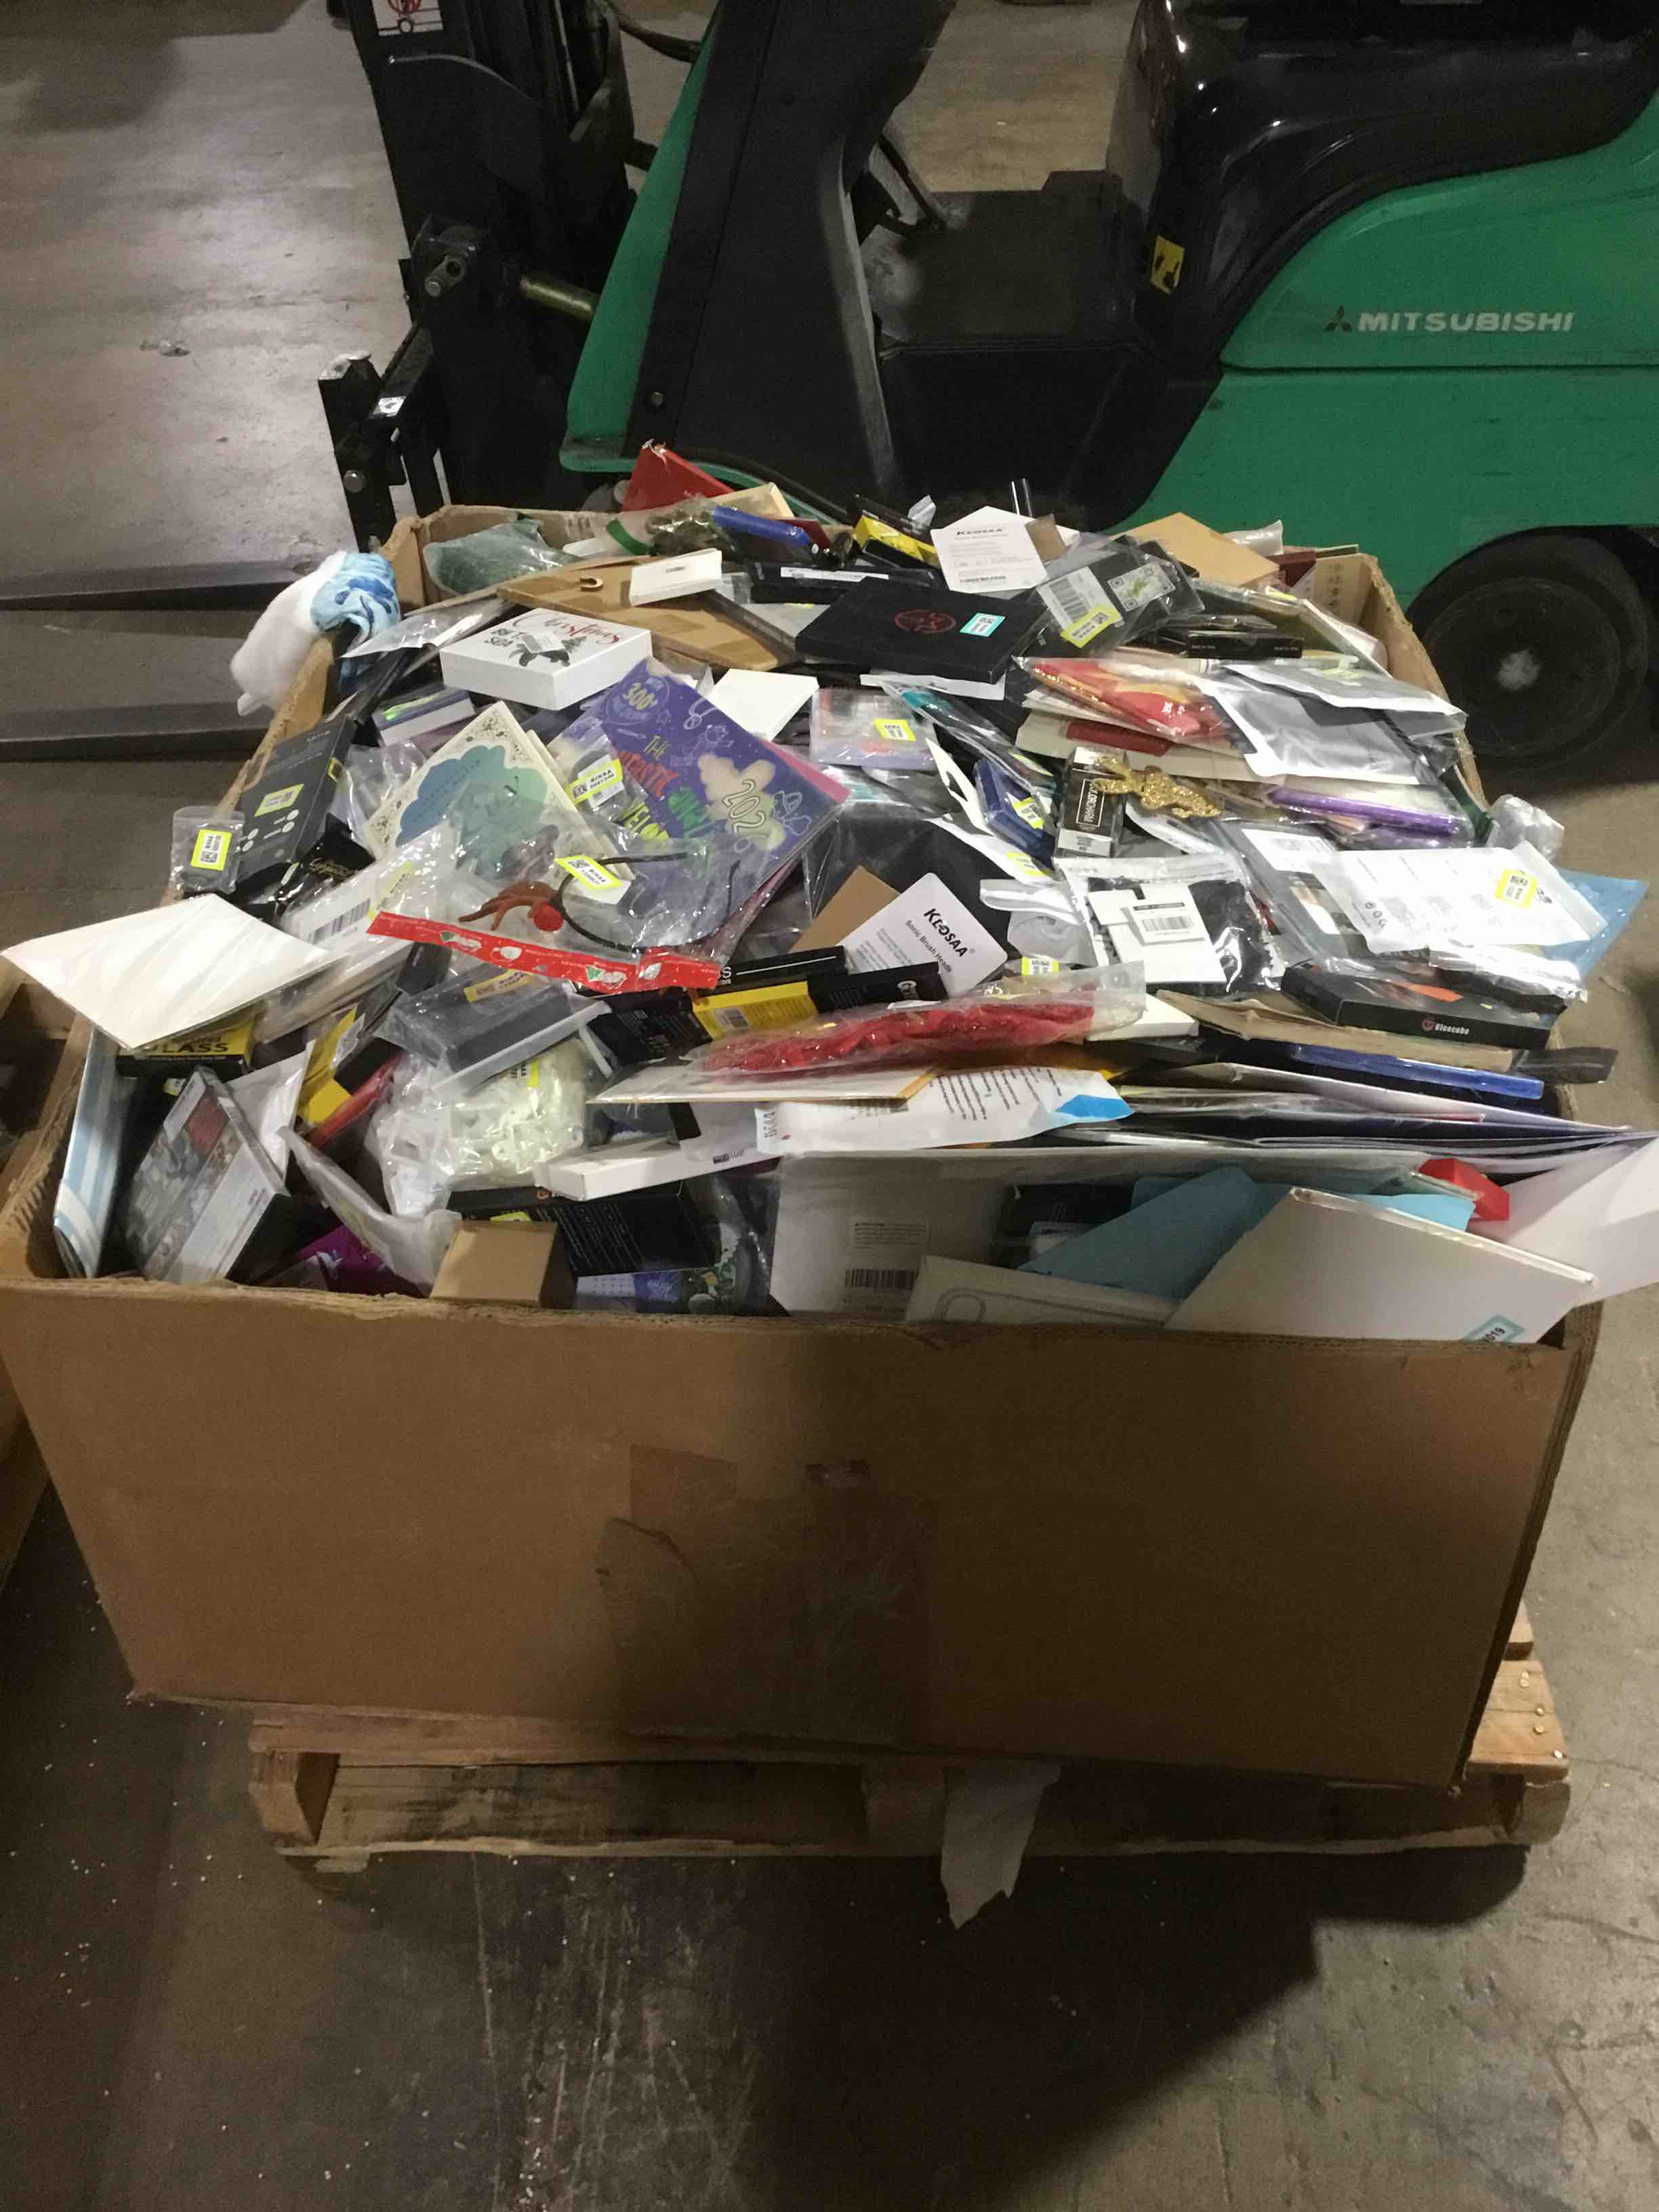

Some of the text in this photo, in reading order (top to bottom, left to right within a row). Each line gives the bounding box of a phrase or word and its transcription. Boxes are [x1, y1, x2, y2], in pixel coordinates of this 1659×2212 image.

[1357, 312, 1574, 331] MITSUBISHI
[905, 920, 921, 938] Sonic
[919, 935, 937, 955] Brush
